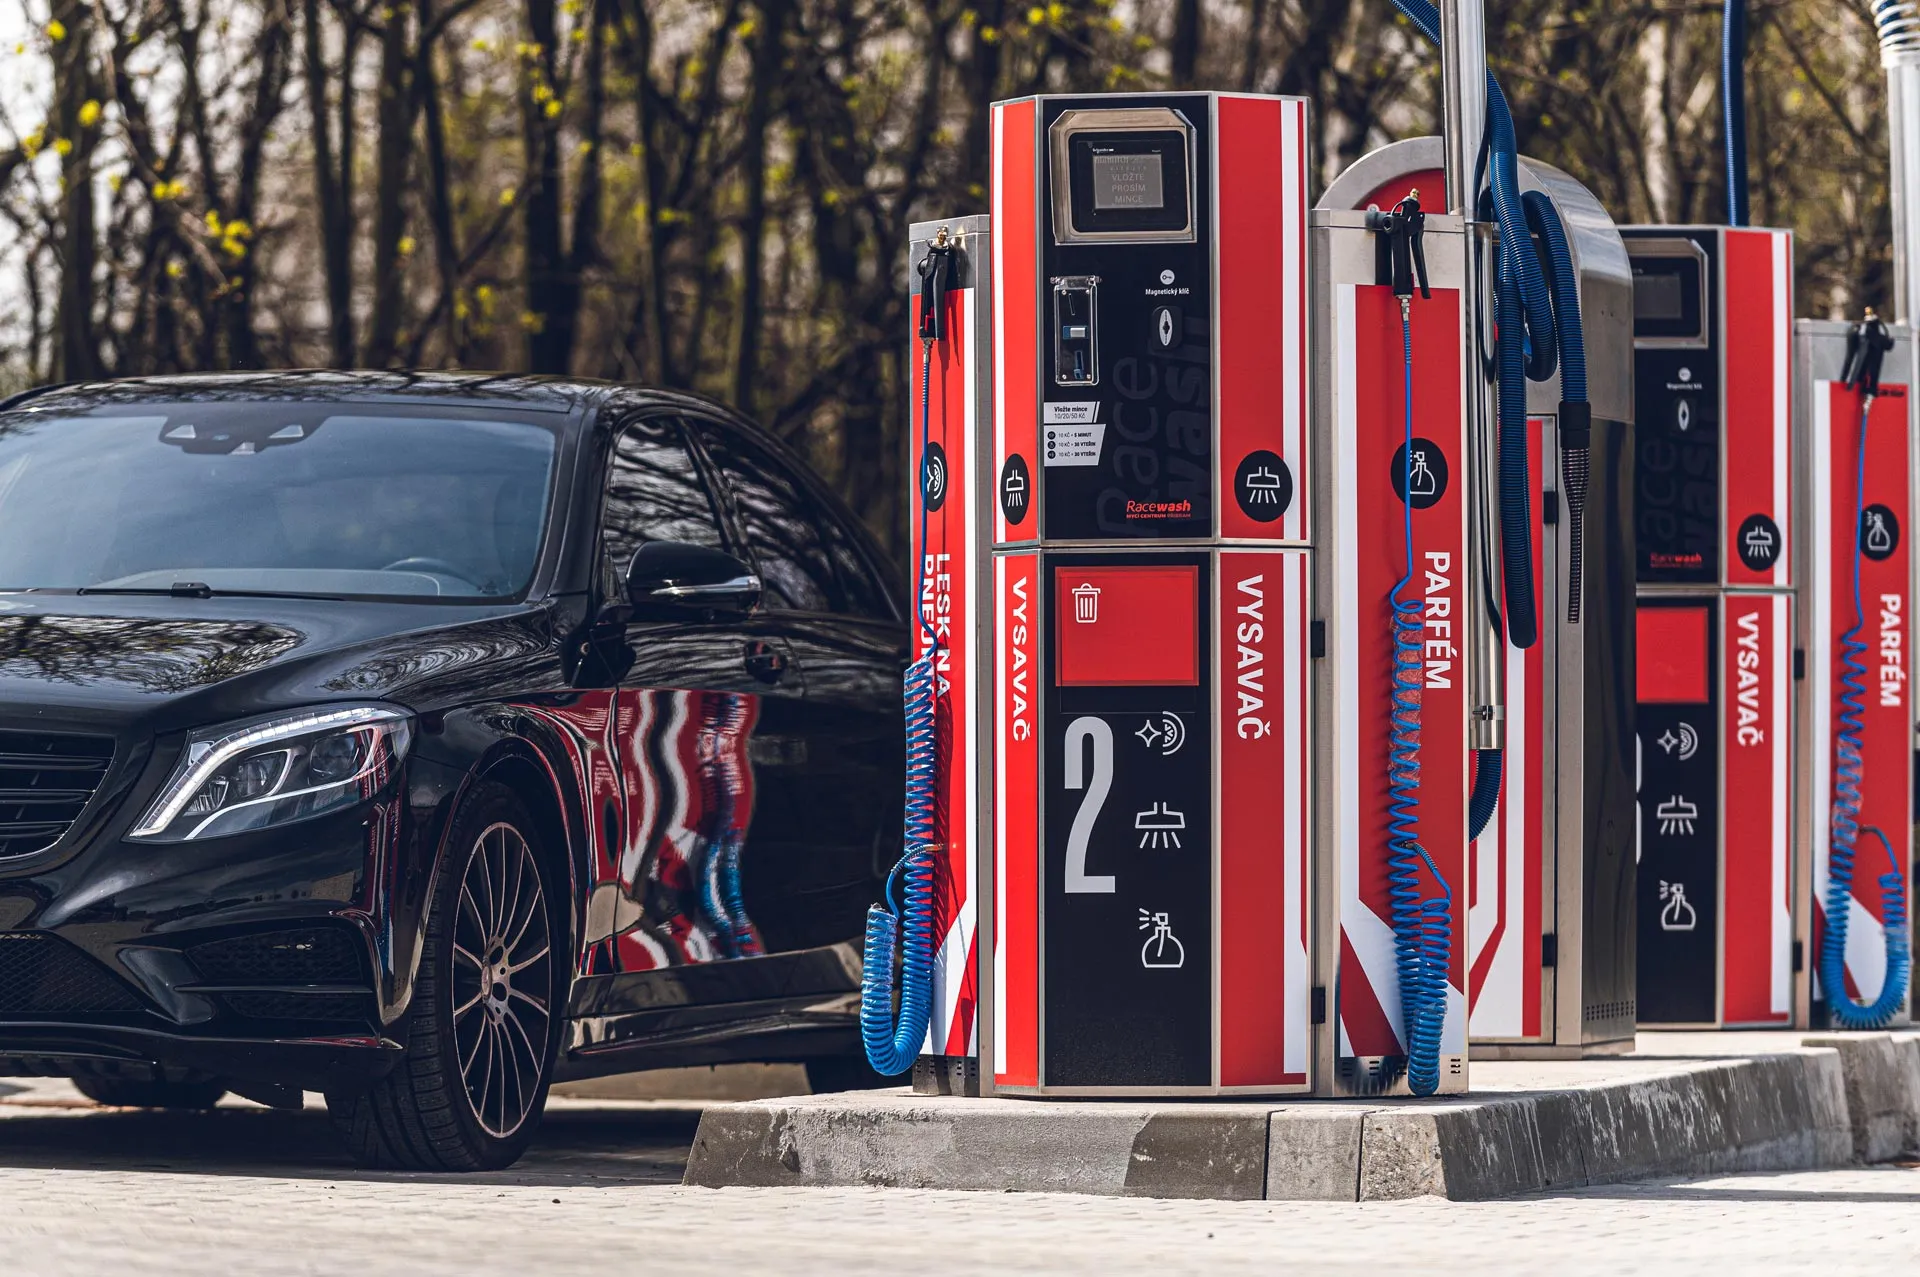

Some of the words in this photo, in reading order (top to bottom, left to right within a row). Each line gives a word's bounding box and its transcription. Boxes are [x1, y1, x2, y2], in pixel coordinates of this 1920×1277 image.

[1115, 195, 1144, 203] MINCE
[1126, 499, 1191, 512] Racewash
[936, 553, 951, 638] LESK
[1237, 574, 1271, 740] VYSAVAČ
[1425, 551, 1458, 689] PARFÉM
[1880, 593, 1906, 707] PARFÉM
[936, 649, 951, 698] NA
[1012, 576, 1031, 741] VYSAVAČ
[1737, 612, 1764, 747] VYSAVAČ
[1064, 716, 1116, 894] 2
